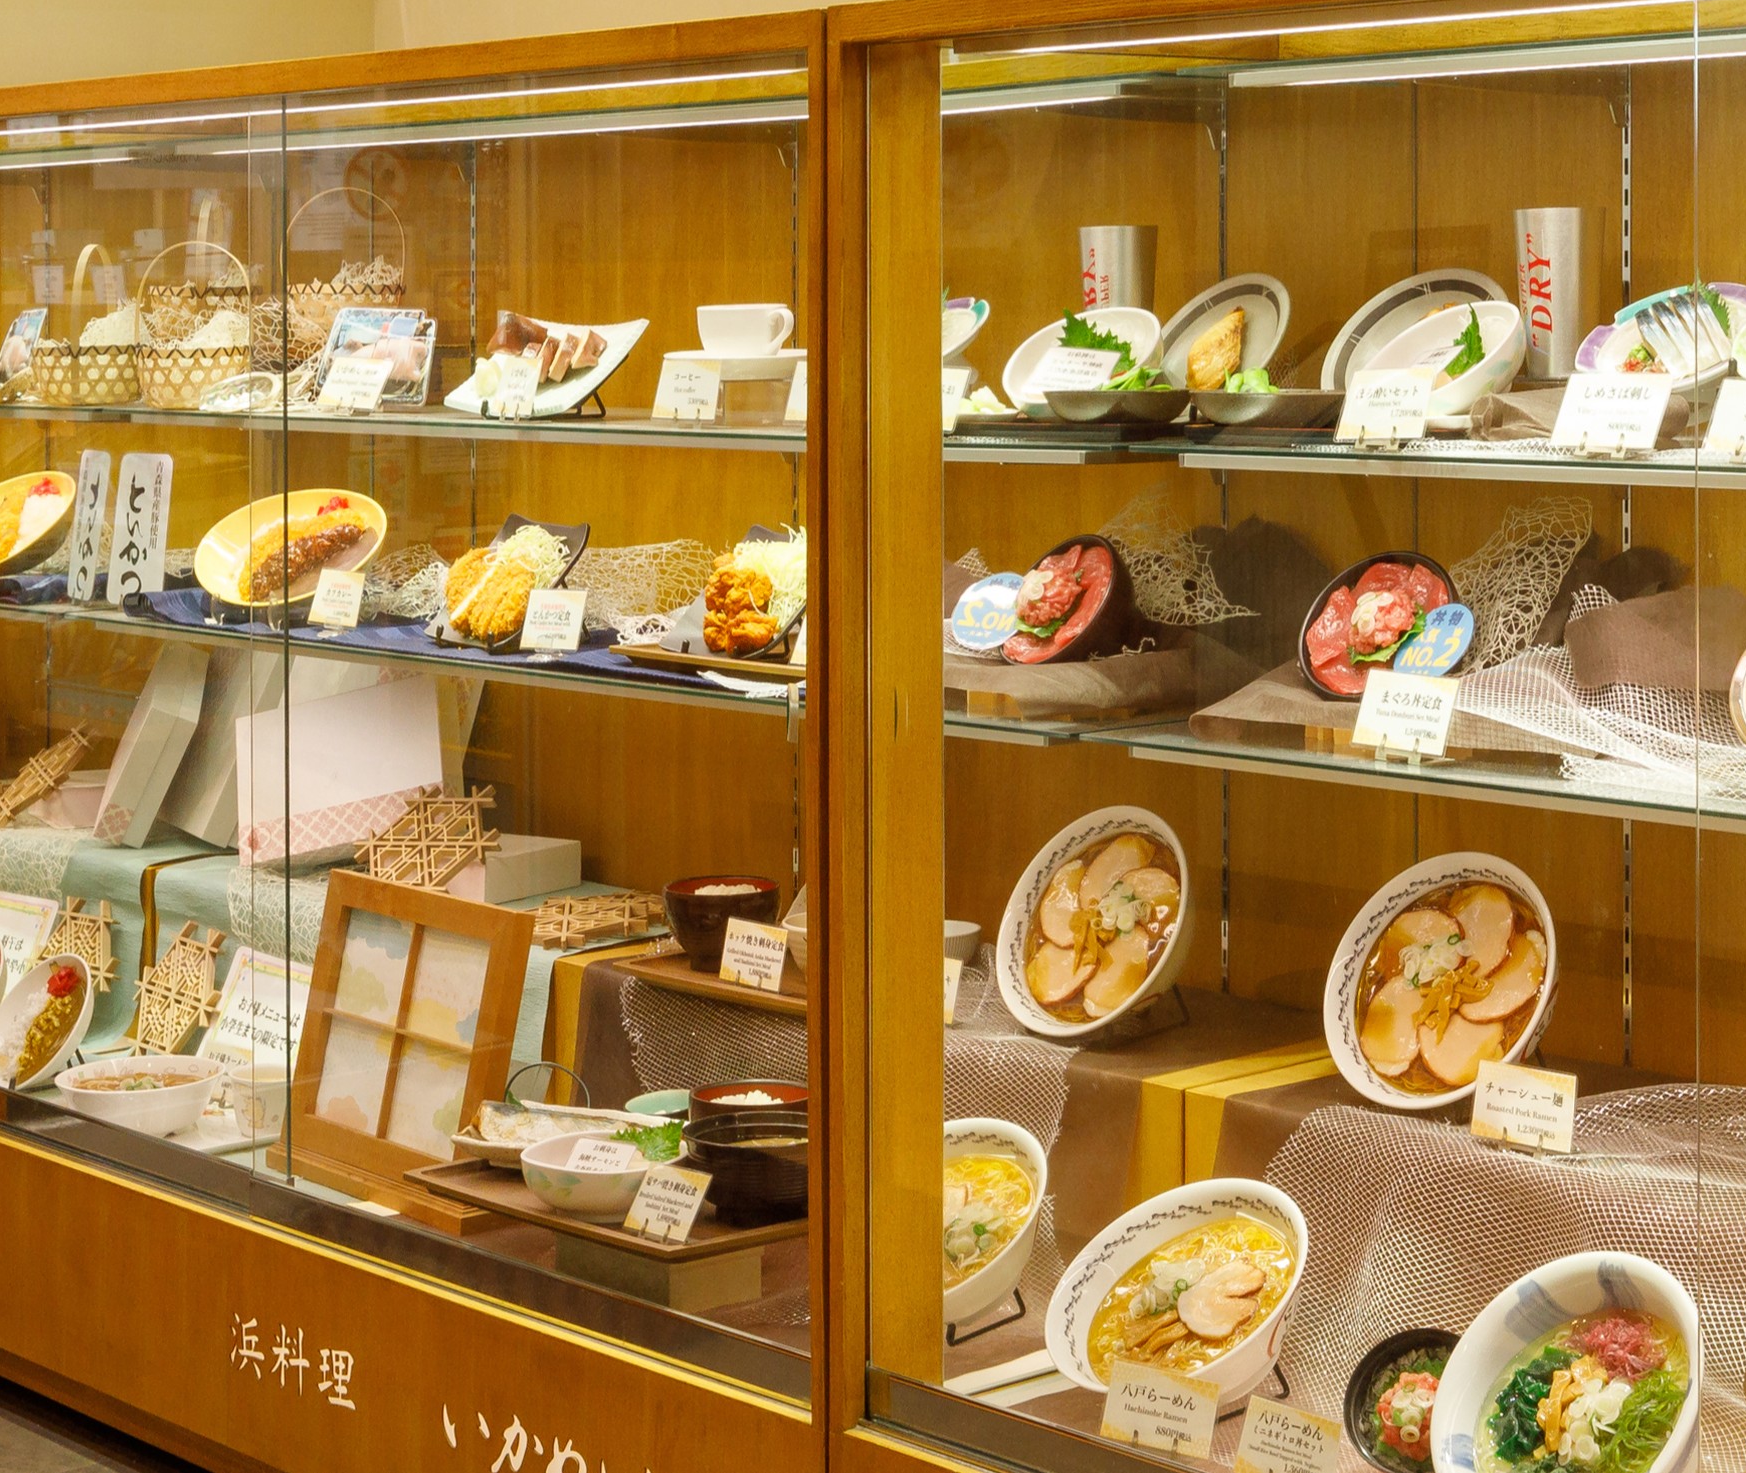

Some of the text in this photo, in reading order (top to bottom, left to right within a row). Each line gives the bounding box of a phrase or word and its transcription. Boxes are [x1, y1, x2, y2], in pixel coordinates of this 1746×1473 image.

[674, 373, 701, 381] コーヒー
[1400, 637, 1461, 667] NO.2
[1381, 690, 1443, 711] まぐろ丼定食
[1486, 1102, 1558, 1123] Roasted Pork Ramen
[230, 1312, 357, 1412] 浜料理
[1121, 1384, 1197, 1412] 八戸らーめん
[1123, 1403, 1188, 1424] Hachinohe Ramen
[1258, 1410, 1324, 1442] 八戸らーめん
[443, 1403, 652, 1473] いかめ
